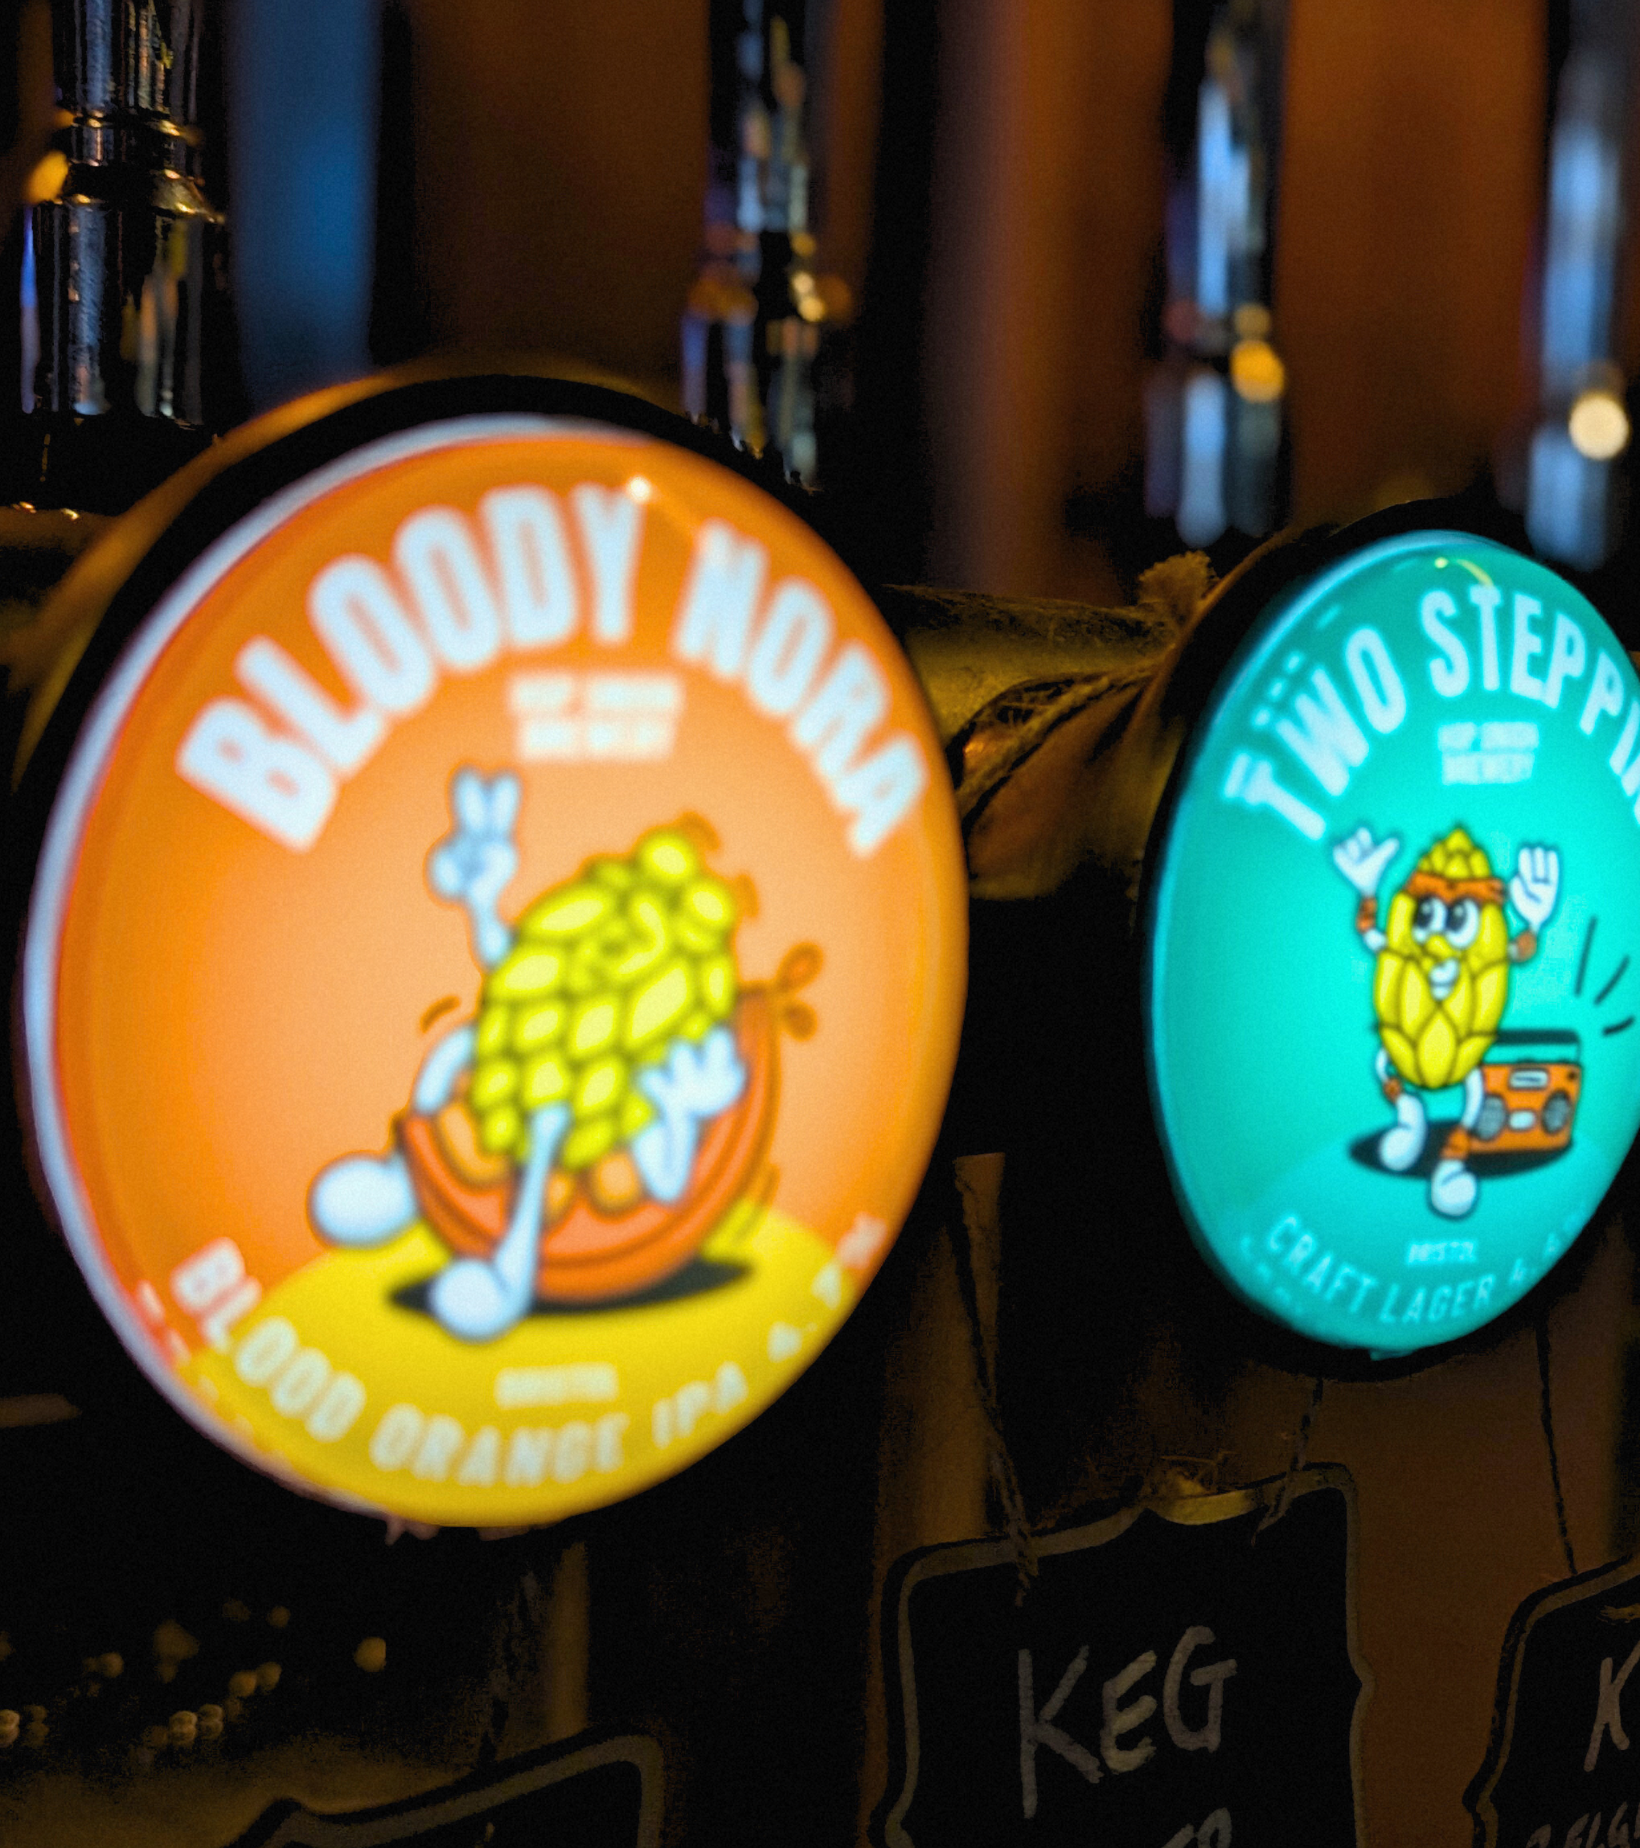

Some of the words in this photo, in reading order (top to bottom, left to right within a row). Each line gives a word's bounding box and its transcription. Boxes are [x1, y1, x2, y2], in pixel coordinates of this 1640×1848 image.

[176, 484, 646, 852] BLOODY
[673, 518, 928, 858] NORA
[1224, 627, 1407, 841] TWO
[172, 1238, 366, 1444] BLOOD
[369, 1404, 630, 1488] ORANGE
[651, 1361, 748, 1451] IPA
[1266, 1212, 1377, 1314] CRAFT
[1379, 1273, 1496, 1325] LAGER
[1017, 1625, 1237, 1819] KEG
